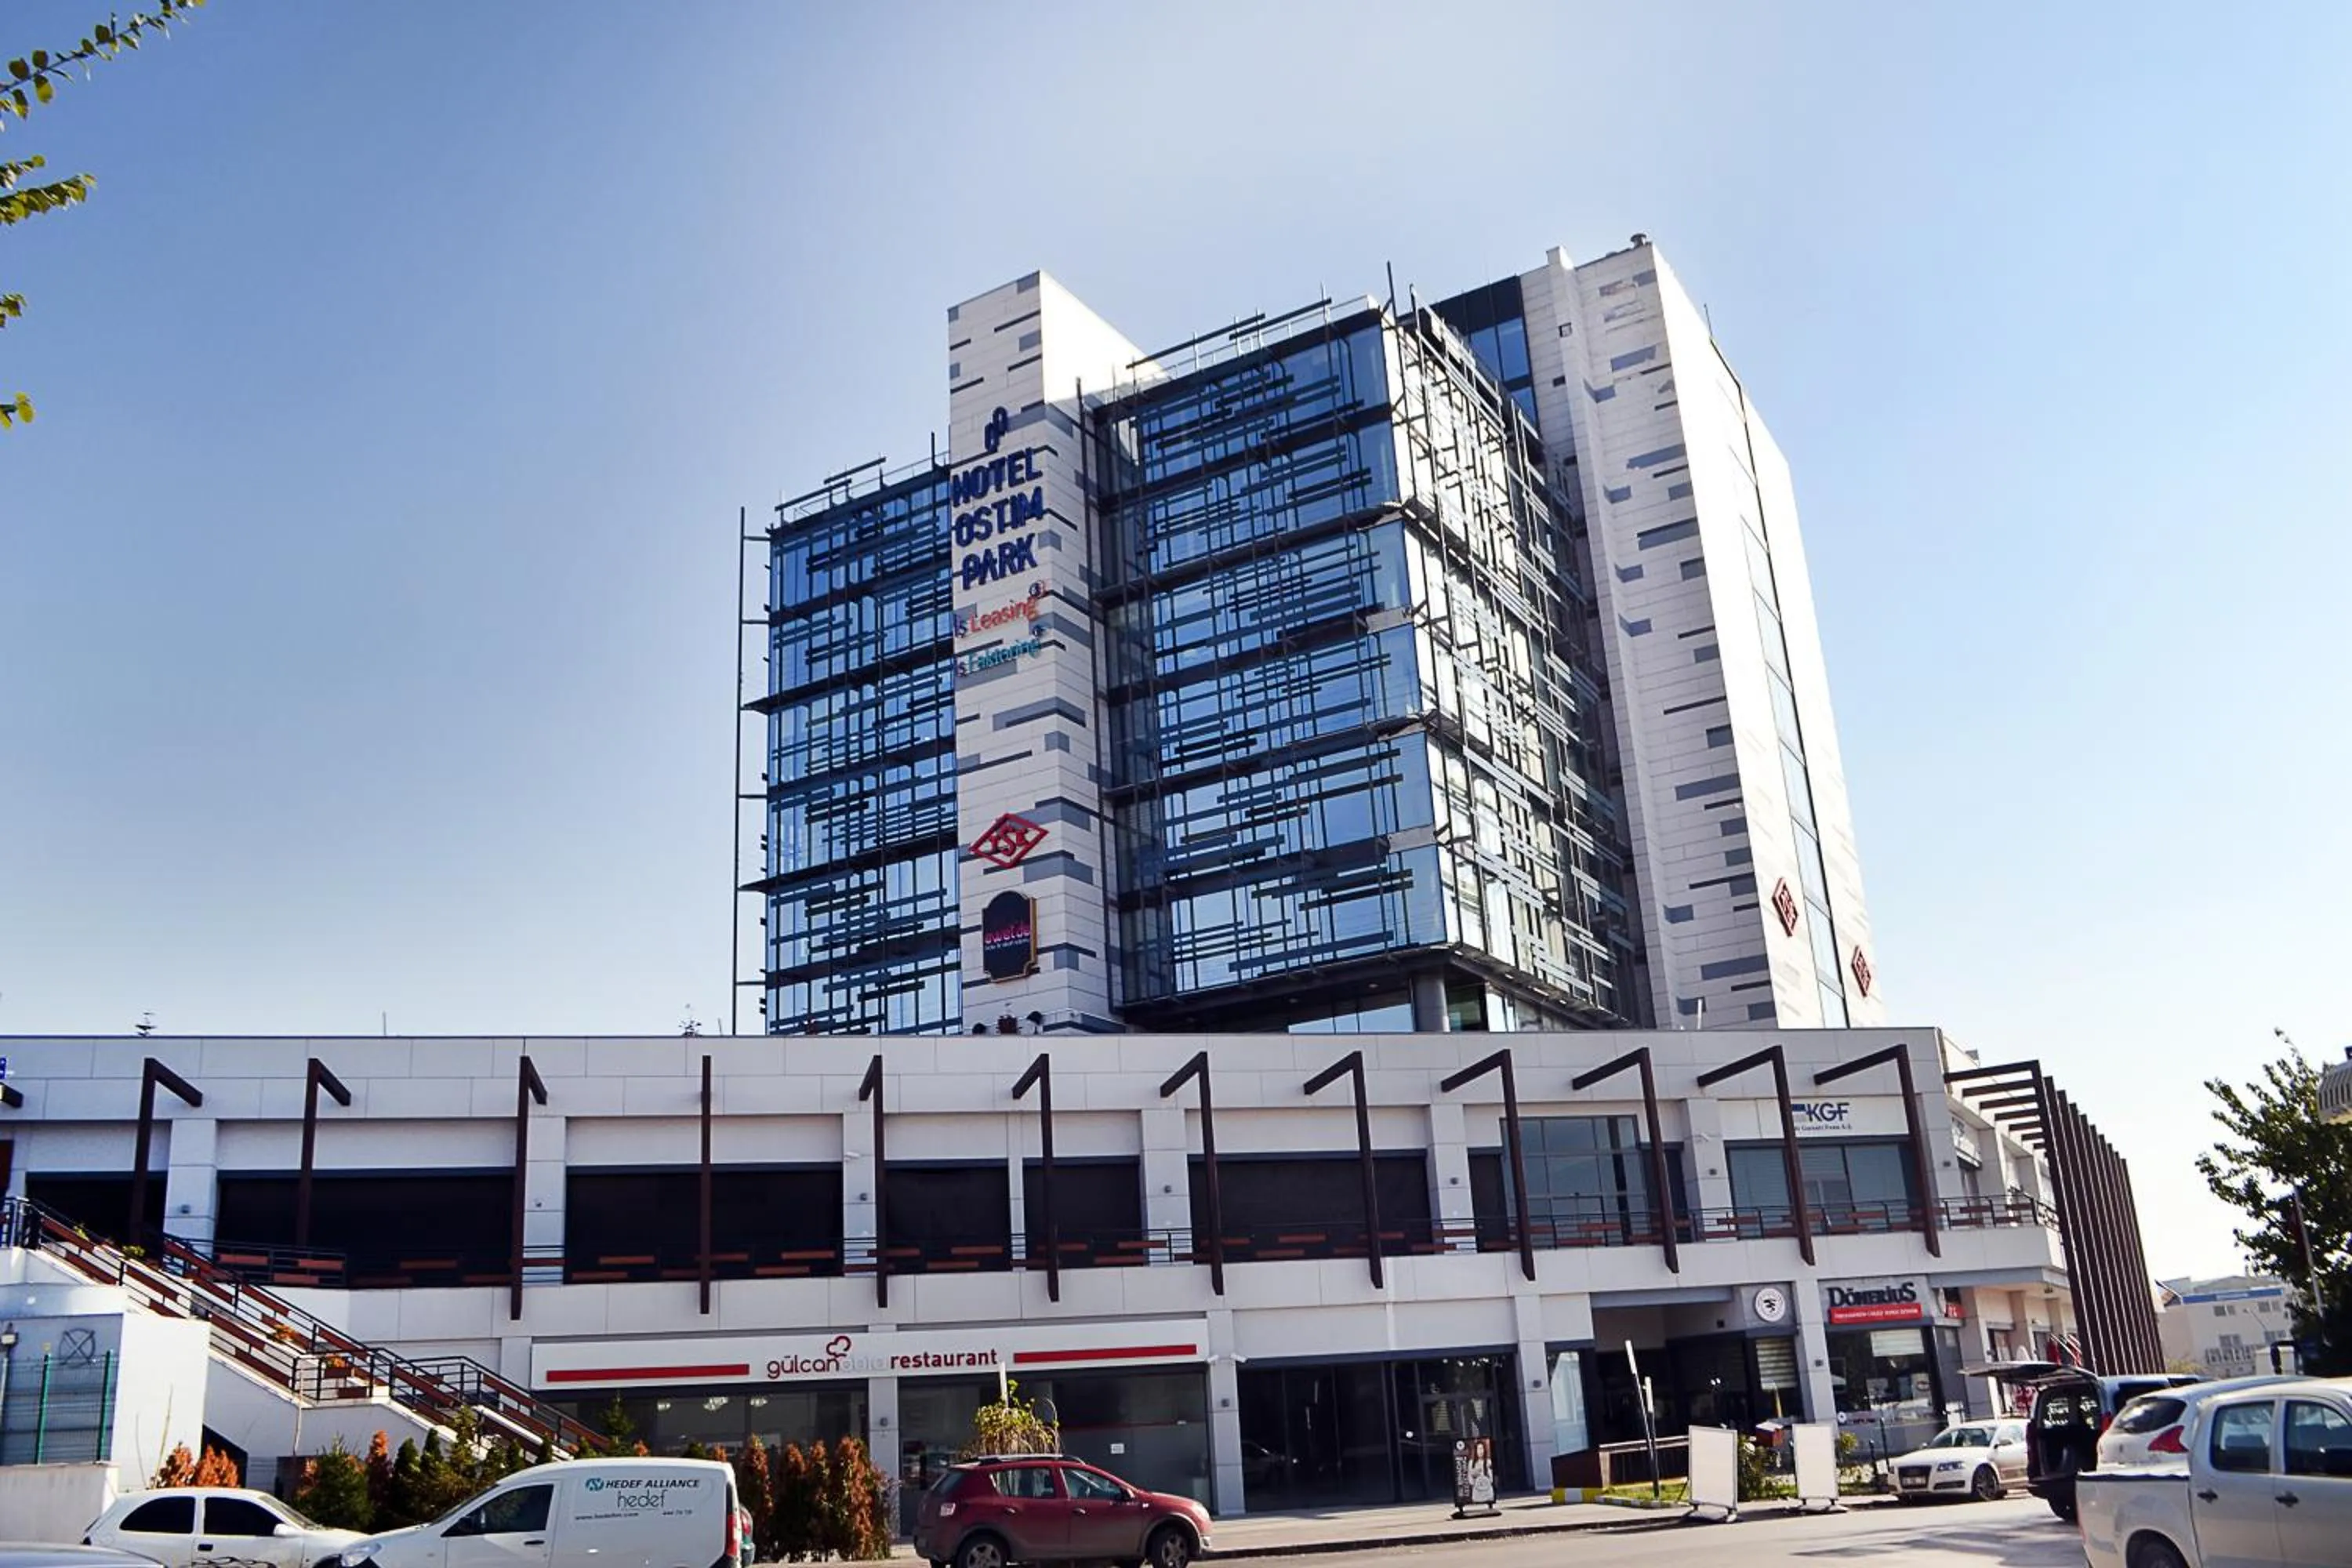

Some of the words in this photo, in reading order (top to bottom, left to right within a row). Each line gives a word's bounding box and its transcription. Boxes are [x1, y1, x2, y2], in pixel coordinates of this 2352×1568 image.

[952, 447, 1043, 507] HOTEL
[962, 533, 1038, 590] PARK
[969, 597, 1038, 632] Leasing
[1806, 1102, 1849, 1121] KGF
[767, 1355, 840, 1379] gülcan
[890, 1348, 997, 1370] restaurant
[606, 1479, 642, 1489] HEDEF
[644, 1479, 700, 1489] ALLIANCE
[617, 1489, 667, 1508] hedef
